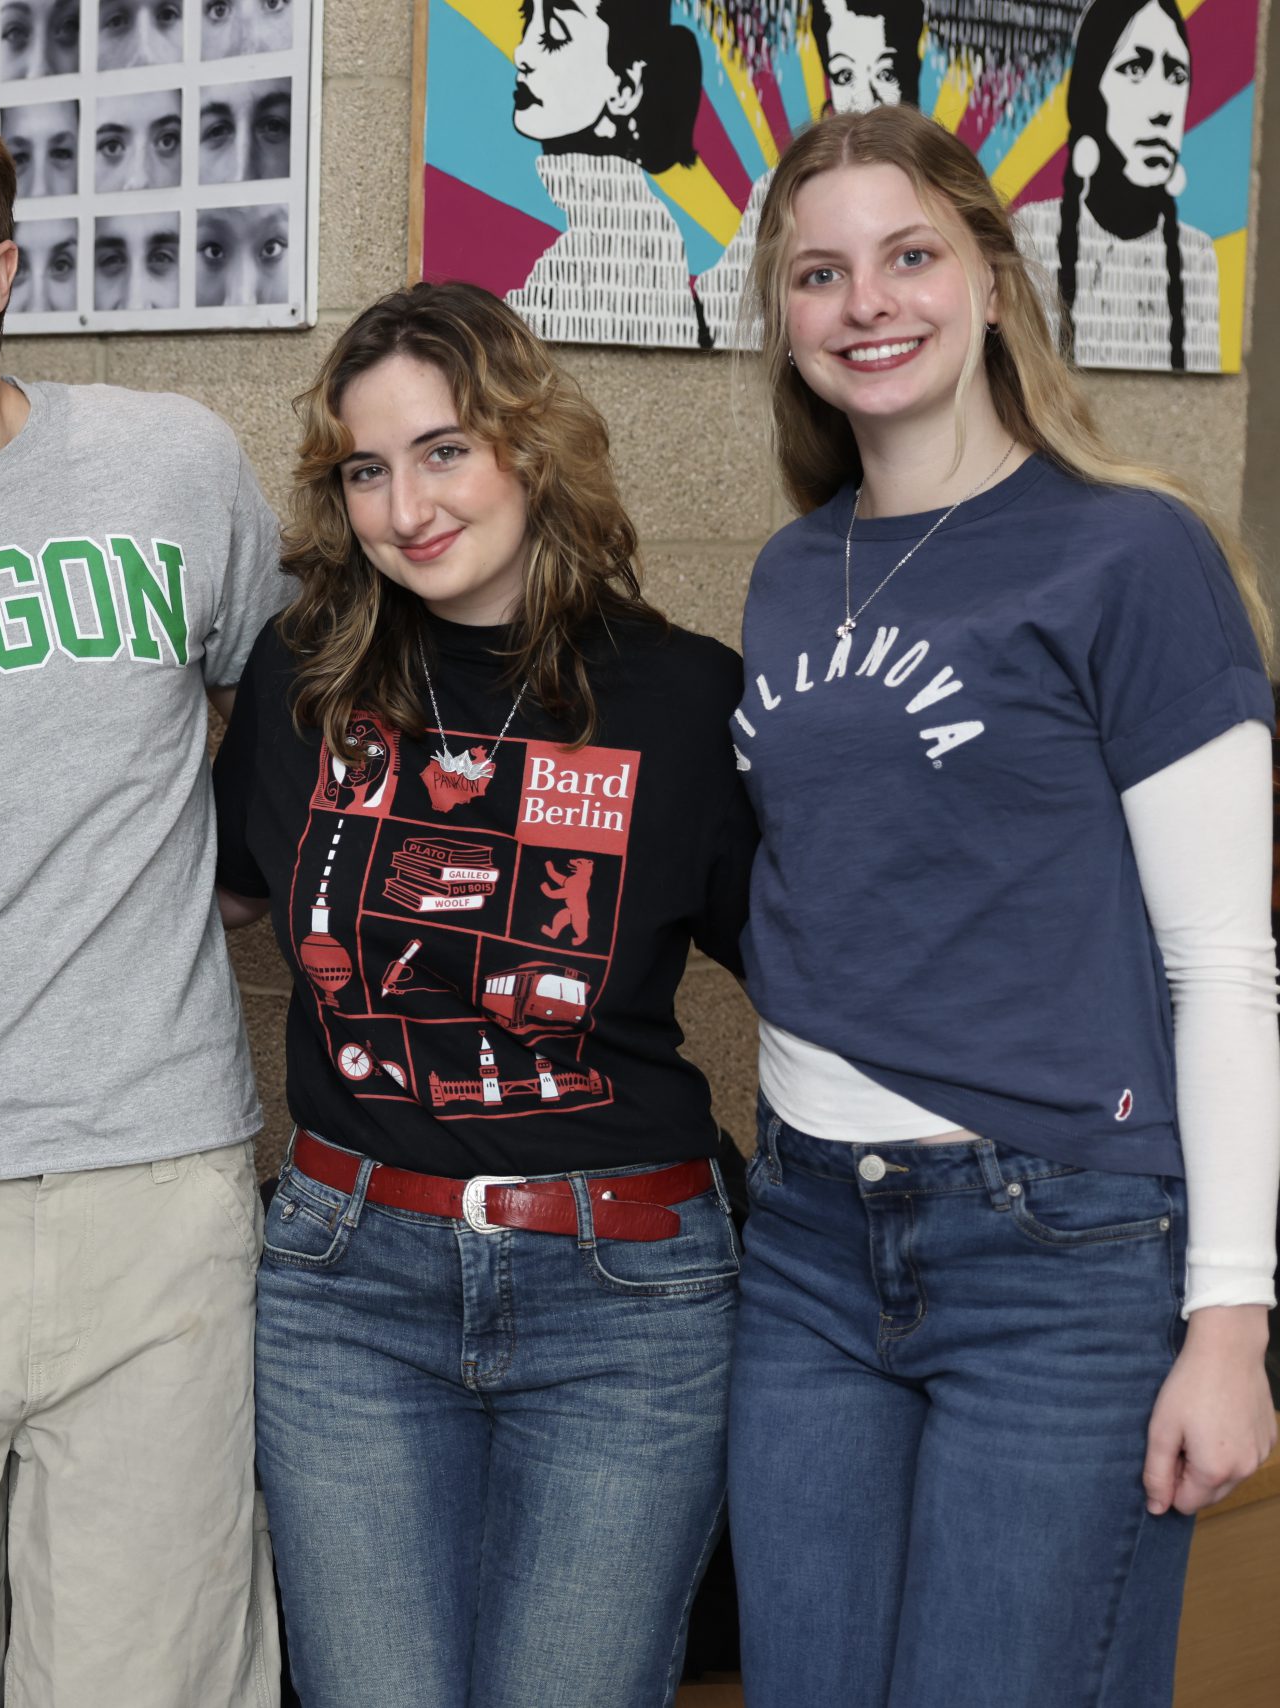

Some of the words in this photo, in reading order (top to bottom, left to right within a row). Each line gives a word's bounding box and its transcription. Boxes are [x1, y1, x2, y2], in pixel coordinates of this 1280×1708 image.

[433, 771, 480, 793] PANKOW
[526, 757, 630, 799] Bard
[521, 797, 625, 832] Berlin
[408, 843, 446, 861] PLATO
[448, 869, 490, 880] GALILEO
[452, 885, 466, 895] DU
[467, 882, 492, 893] BOIS
[434, 898, 471, 908] WOOLF
